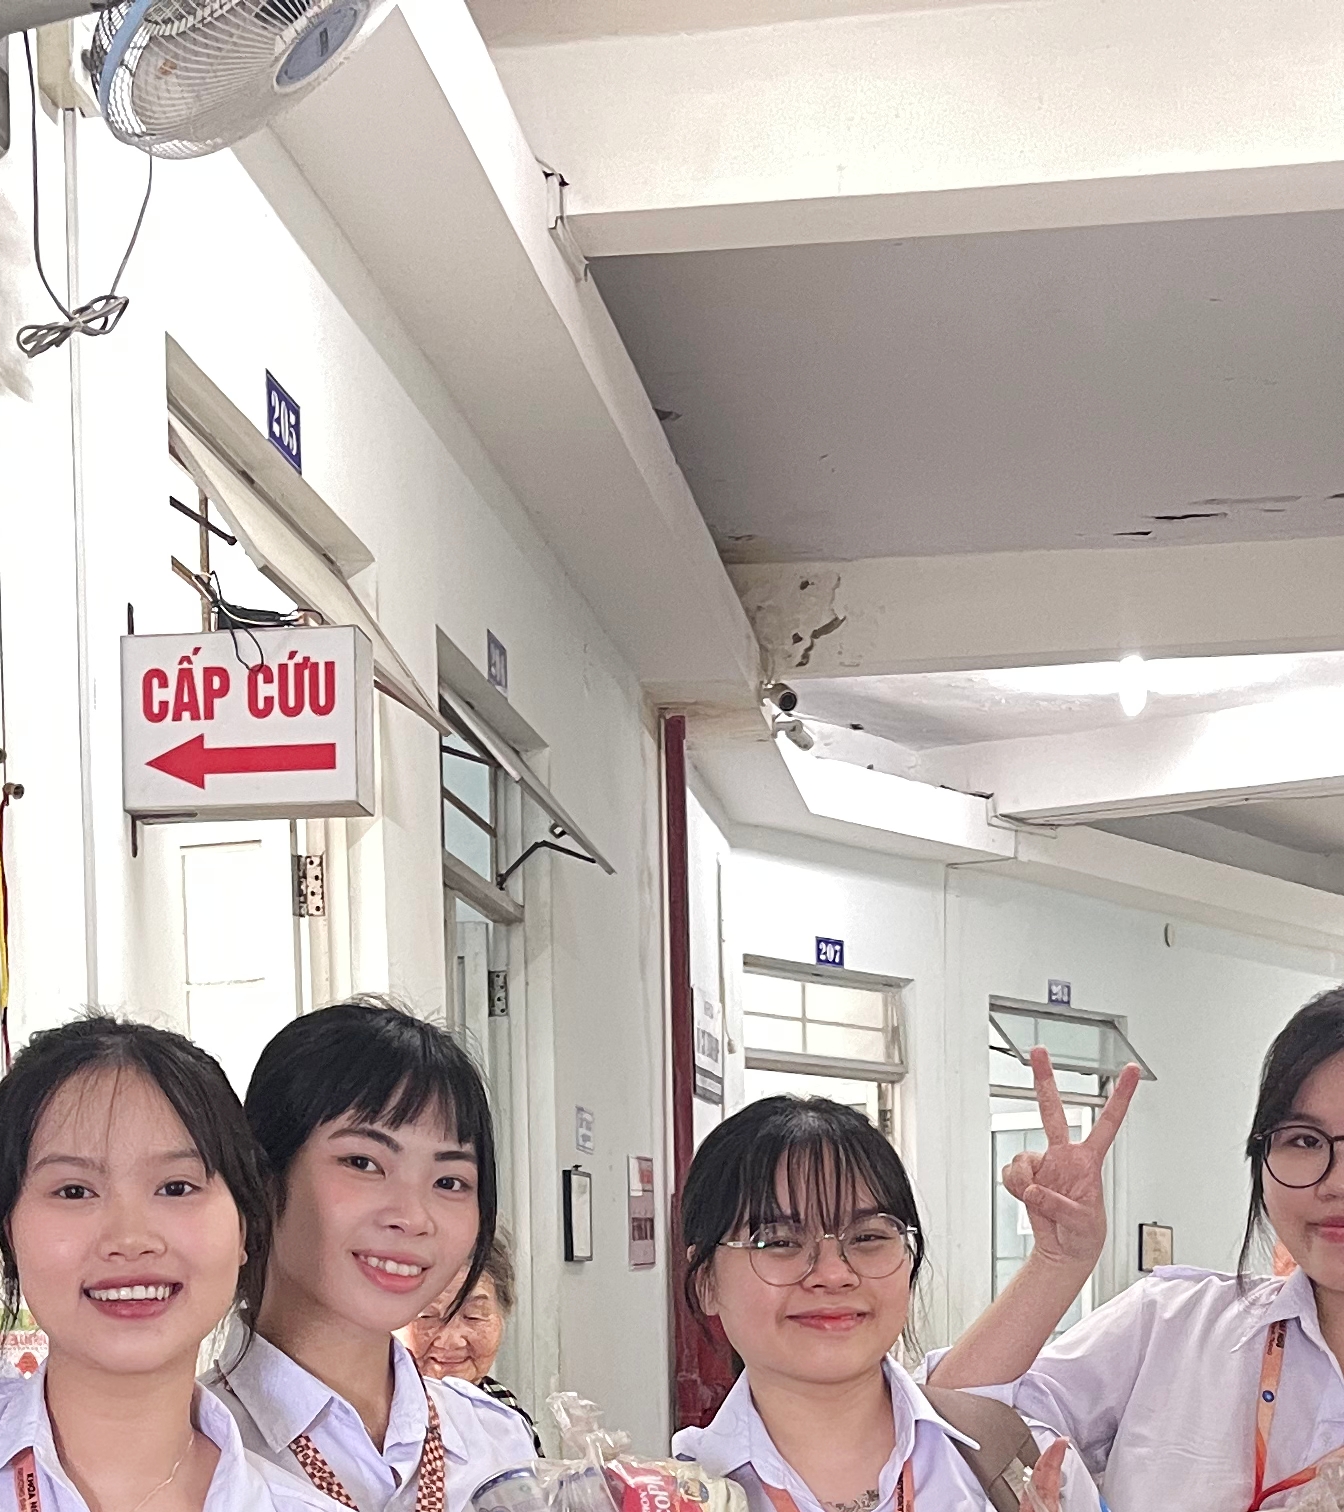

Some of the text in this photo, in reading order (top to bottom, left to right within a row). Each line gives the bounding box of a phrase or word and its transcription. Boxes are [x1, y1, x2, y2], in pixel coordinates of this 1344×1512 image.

[270, 390, 298, 457] 205
[141, 646, 336, 724] CẤP CỨU
[818, 941, 842, 964] 207
